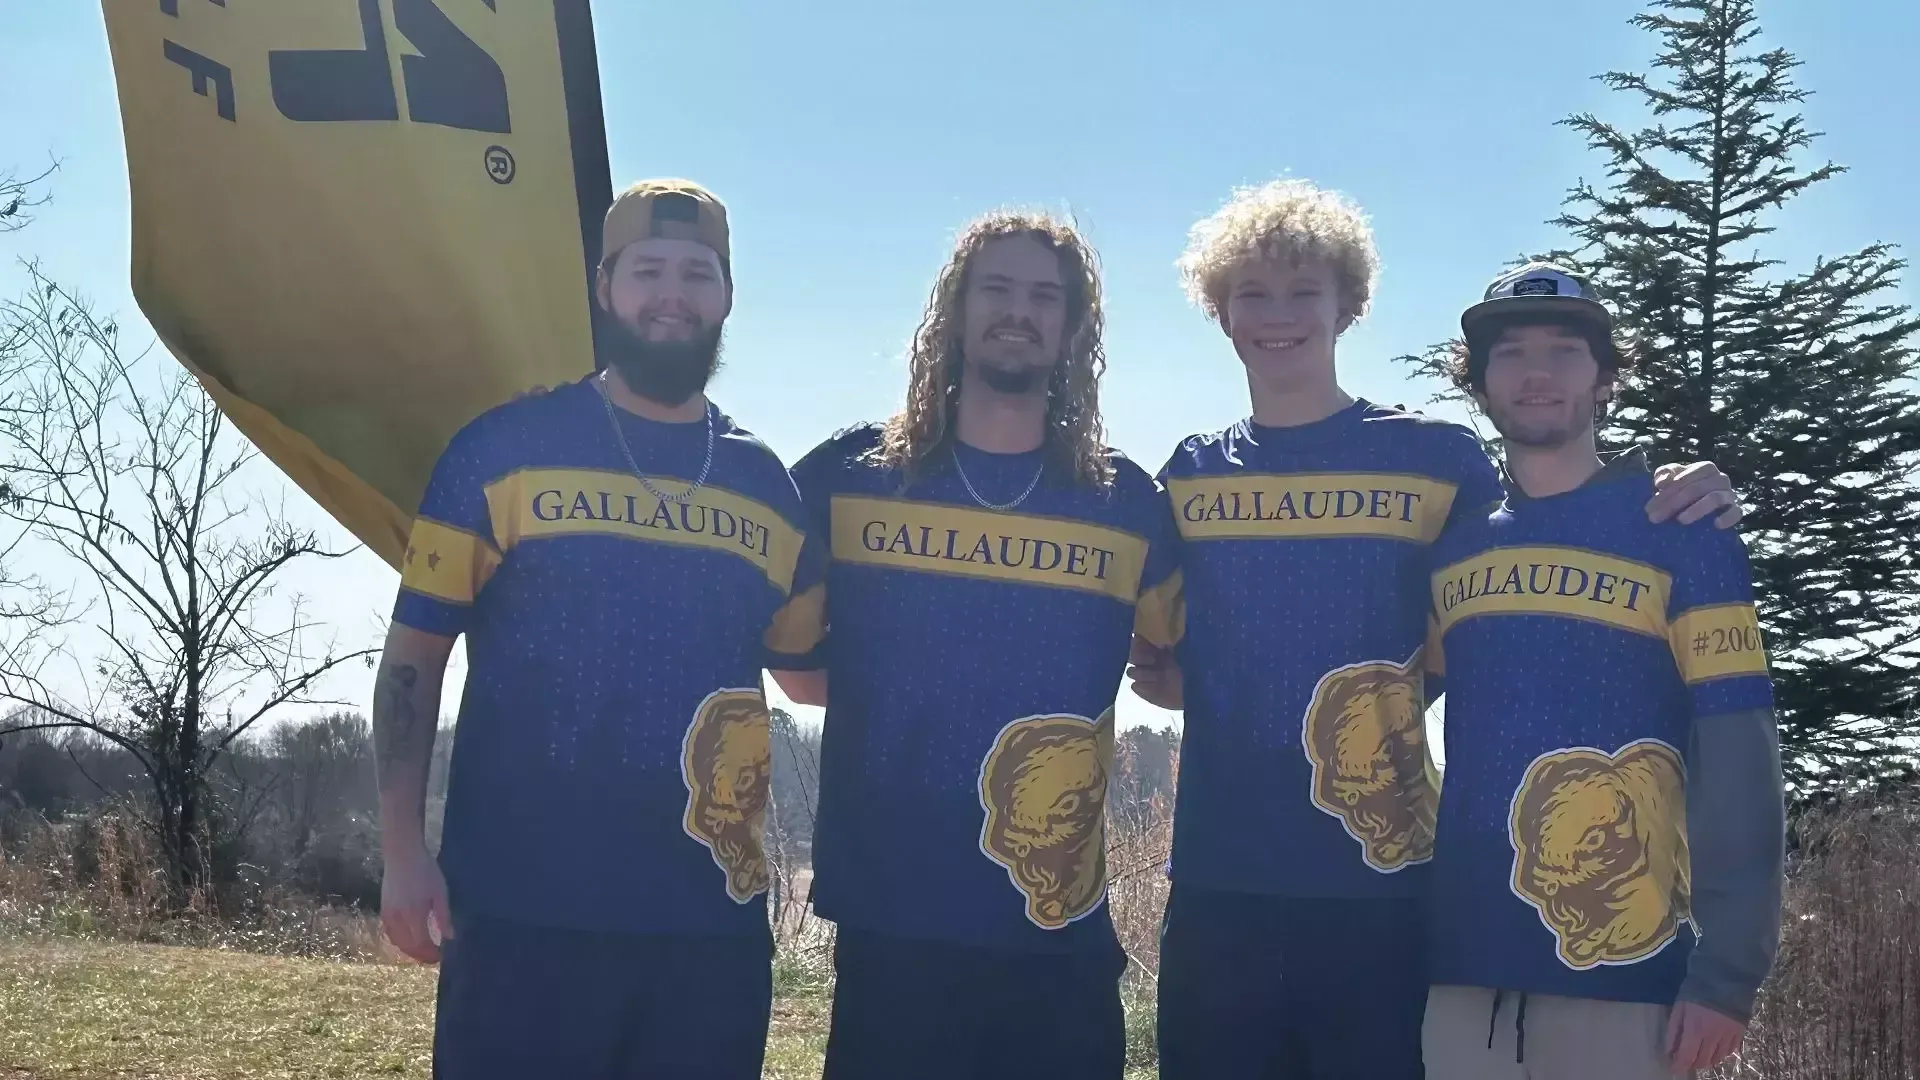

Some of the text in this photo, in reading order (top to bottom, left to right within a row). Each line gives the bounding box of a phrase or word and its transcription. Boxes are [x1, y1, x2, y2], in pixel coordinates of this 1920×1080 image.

[531, 489, 770, 559] GALLAUDET
[1183, 489, 1421, 523] GALLAUDET
[862, 520, 1114, 580] GALLAUDET
[1442, 563, 1651, 612] GALLAUDET
